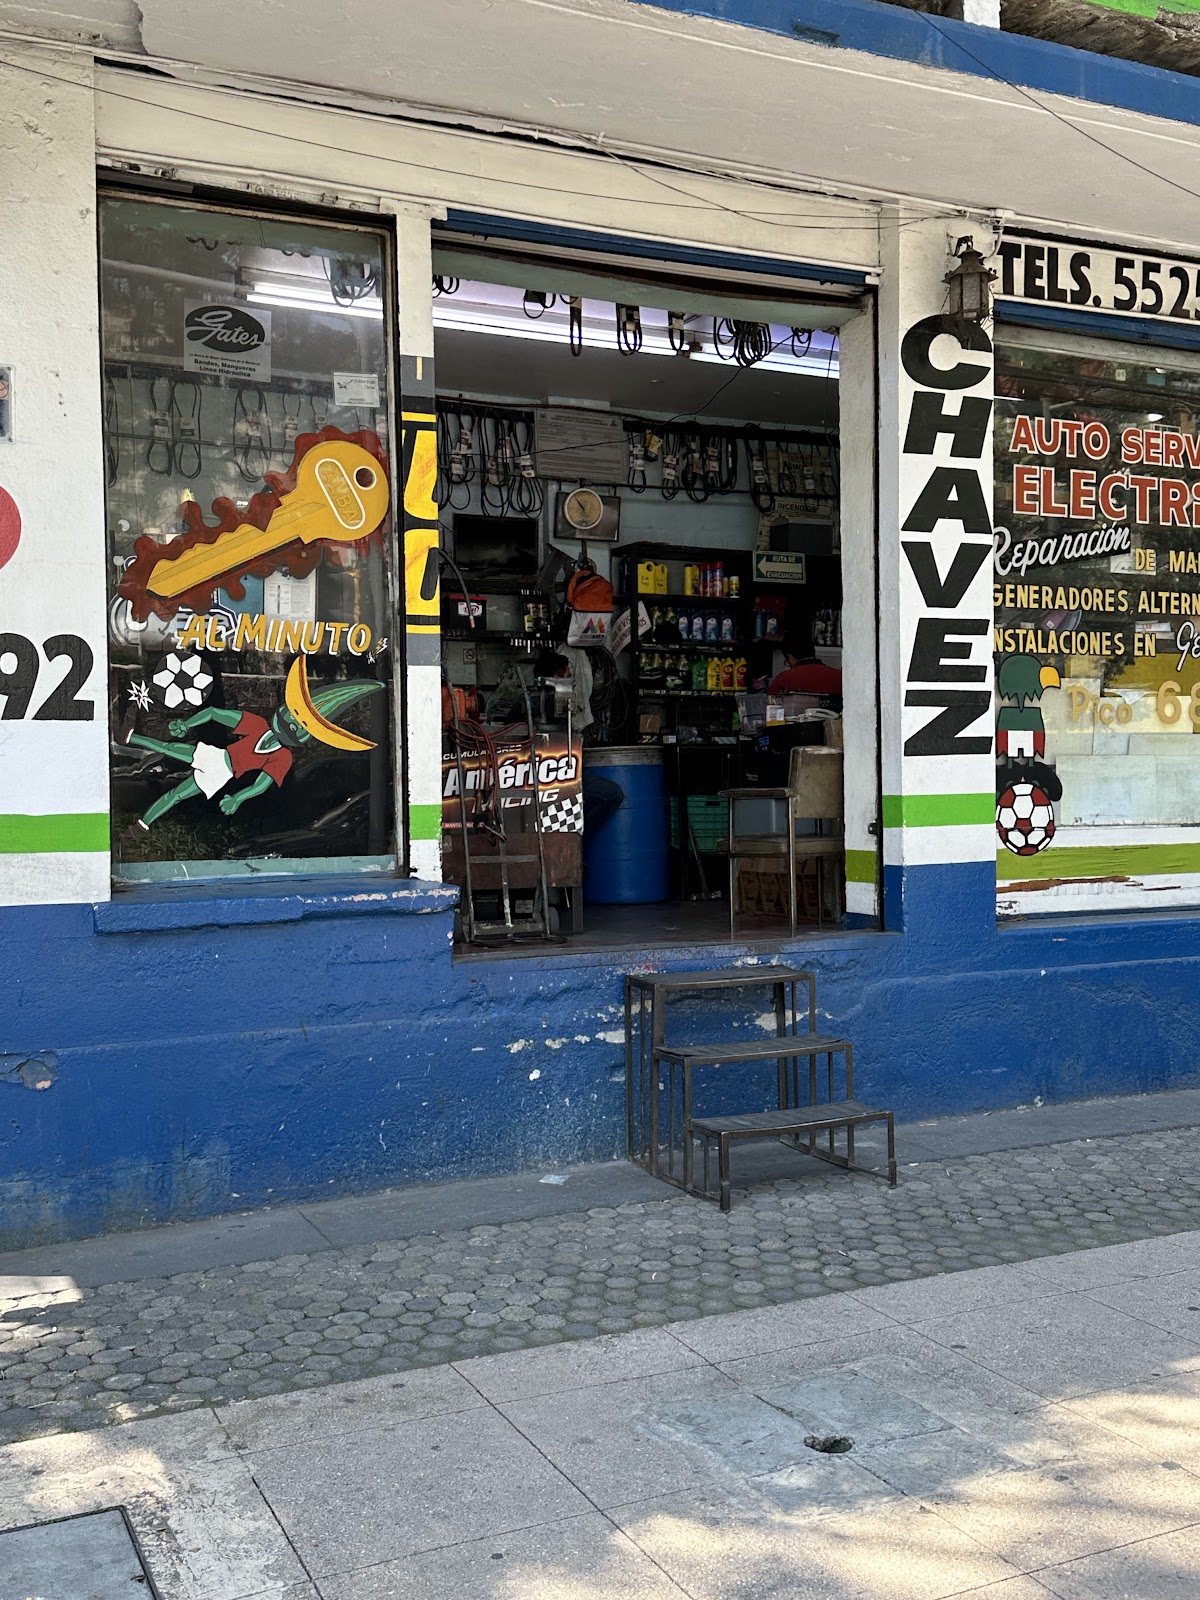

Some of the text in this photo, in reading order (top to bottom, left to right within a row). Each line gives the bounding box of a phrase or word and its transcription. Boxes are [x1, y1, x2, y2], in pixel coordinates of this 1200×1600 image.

[997, 241, 1200, 319] TELS. 552
[185, 310, 262, 345] Gates
[194, 358, 256, 372] Bandas, Mangueras
[1009, 414, 1110, 460] AUTO
[322, 469, 361, 524] ALBA
[900, 313, 994, 757] CHAVEZ
[993, 521, 1200, 577] Reparación DE MA
[772, 555, 787, 563] RUTA
[174, 613, 372, 657] AL MINUTO
[993, 628, 1125, 656] NSTALACIONES
[1133, 632, 1156, 658] EN
[1067, 684, 1133, 725] Pico
